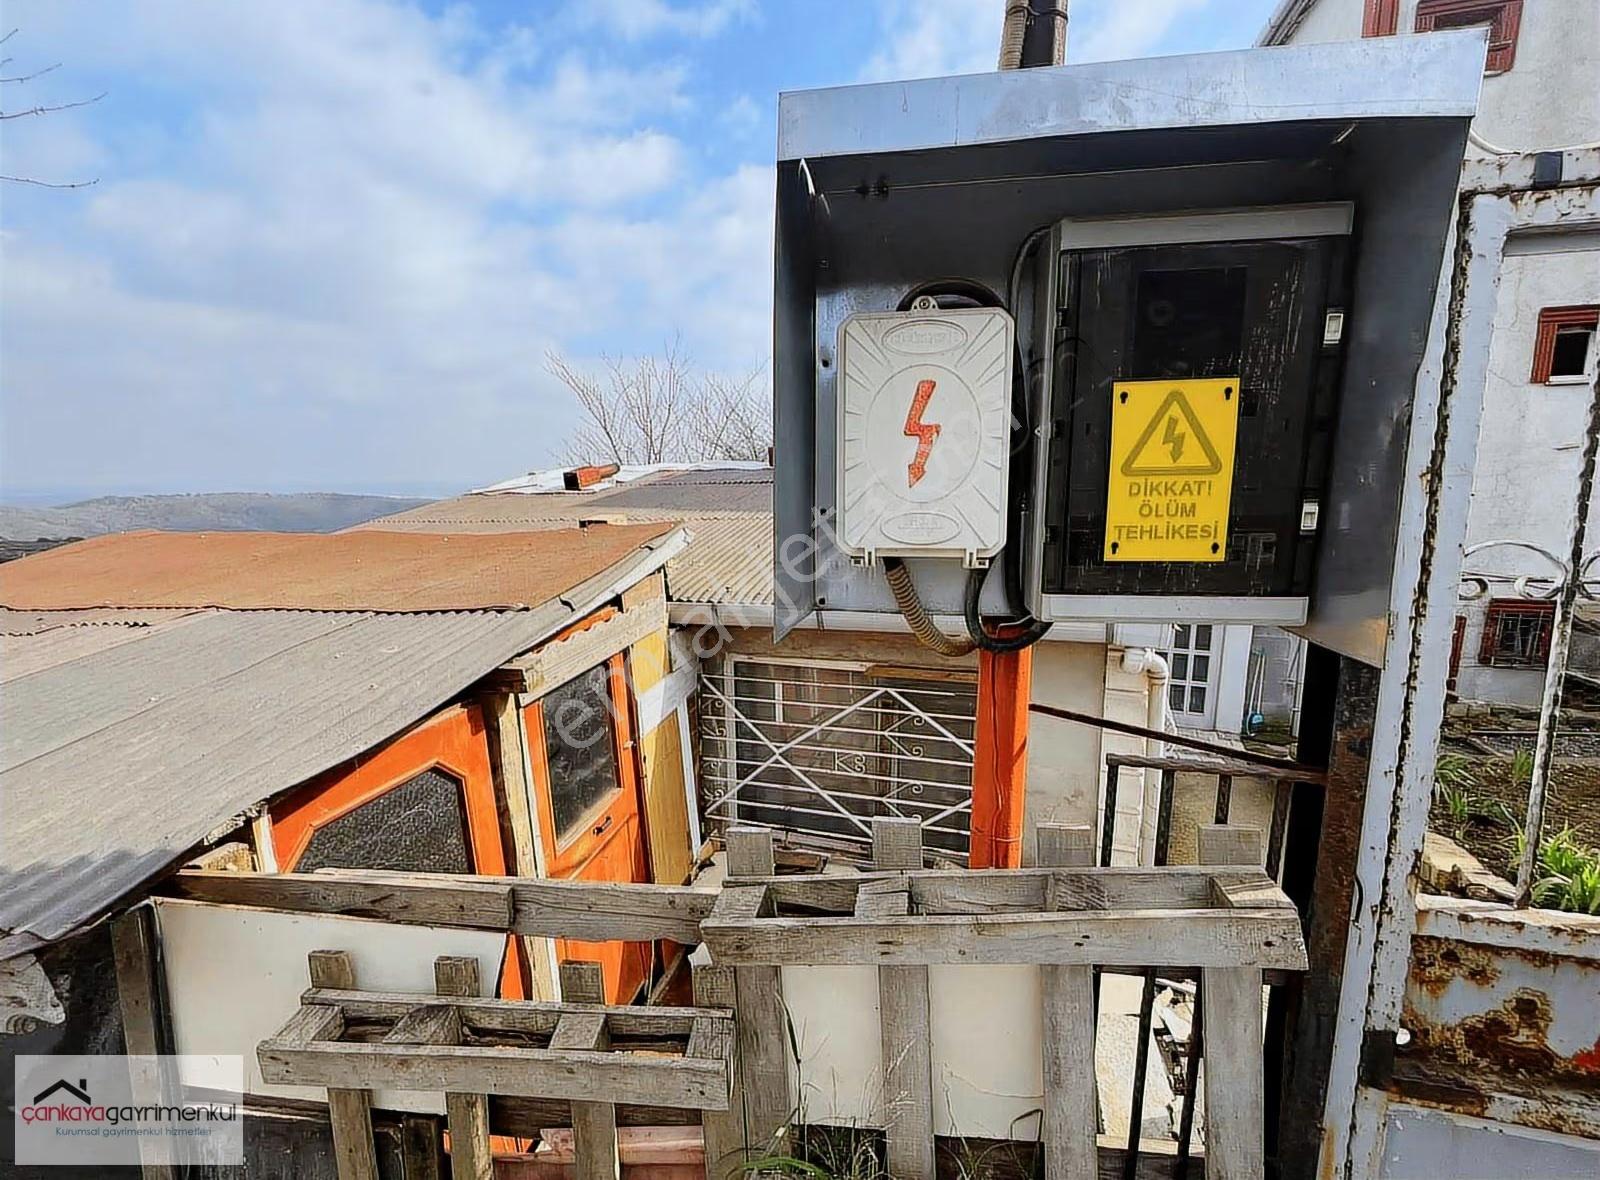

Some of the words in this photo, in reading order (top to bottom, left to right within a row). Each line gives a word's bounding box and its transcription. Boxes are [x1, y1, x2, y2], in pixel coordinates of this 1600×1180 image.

[1128, 478, 1213, 497] DİKKAT!
[1138, 500, 1196, 518] ÖLÜM
[1113, 521, 1219, 540] TEHLİKESİ
